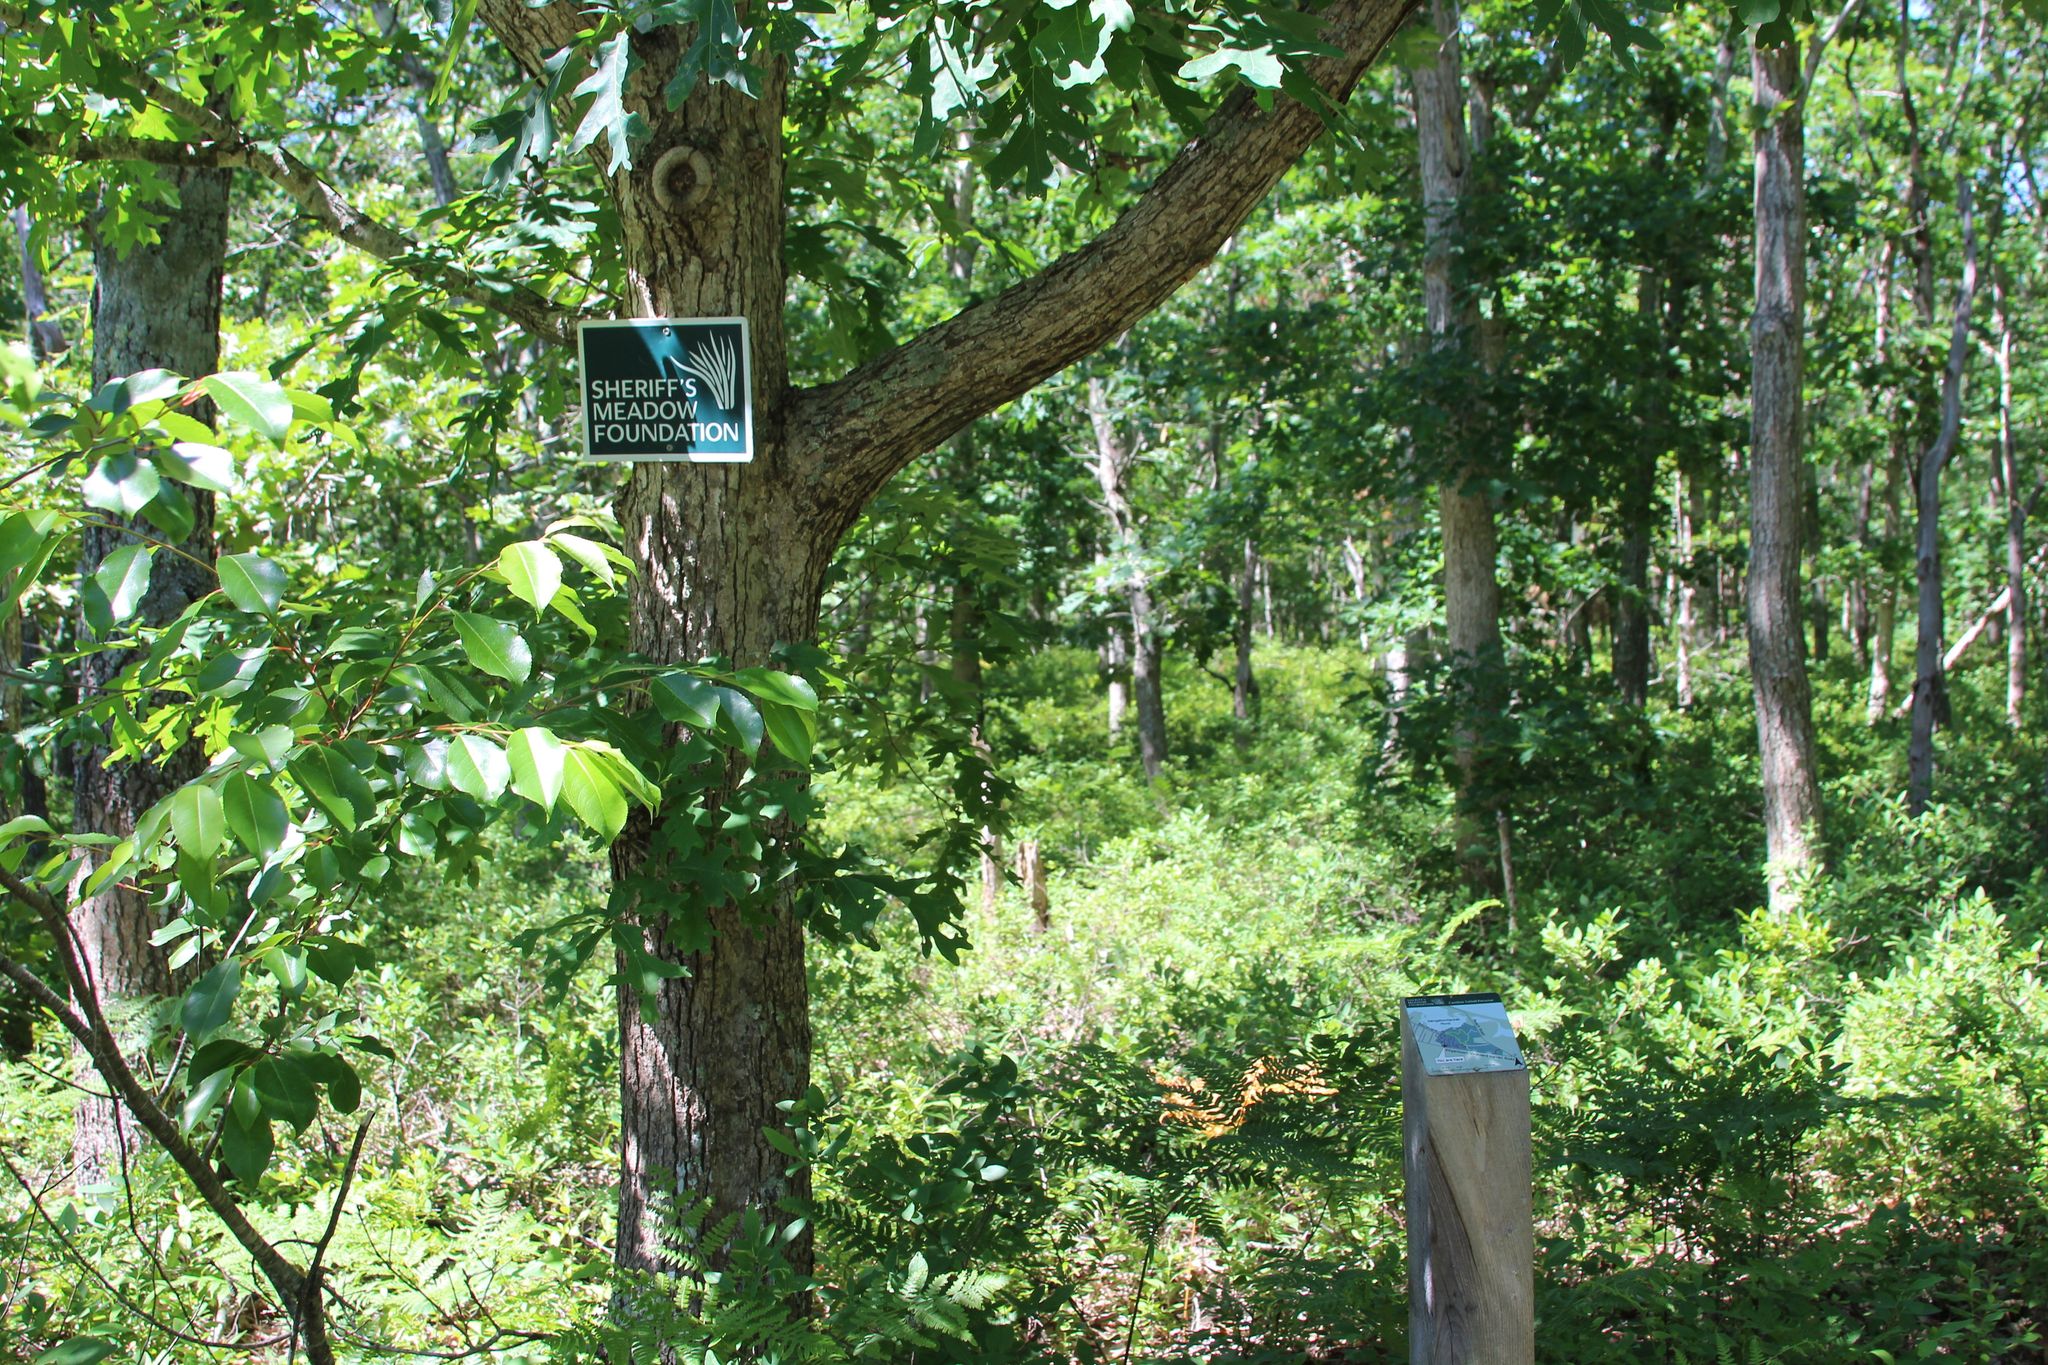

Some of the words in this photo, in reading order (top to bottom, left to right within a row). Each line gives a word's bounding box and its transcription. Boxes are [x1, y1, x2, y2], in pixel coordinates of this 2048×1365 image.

[591, 378, 697, 399] SHERIFF'S
[593, 401, 698, 421] MEADOW
[594, 422, 739, 443] FOUNDATION
